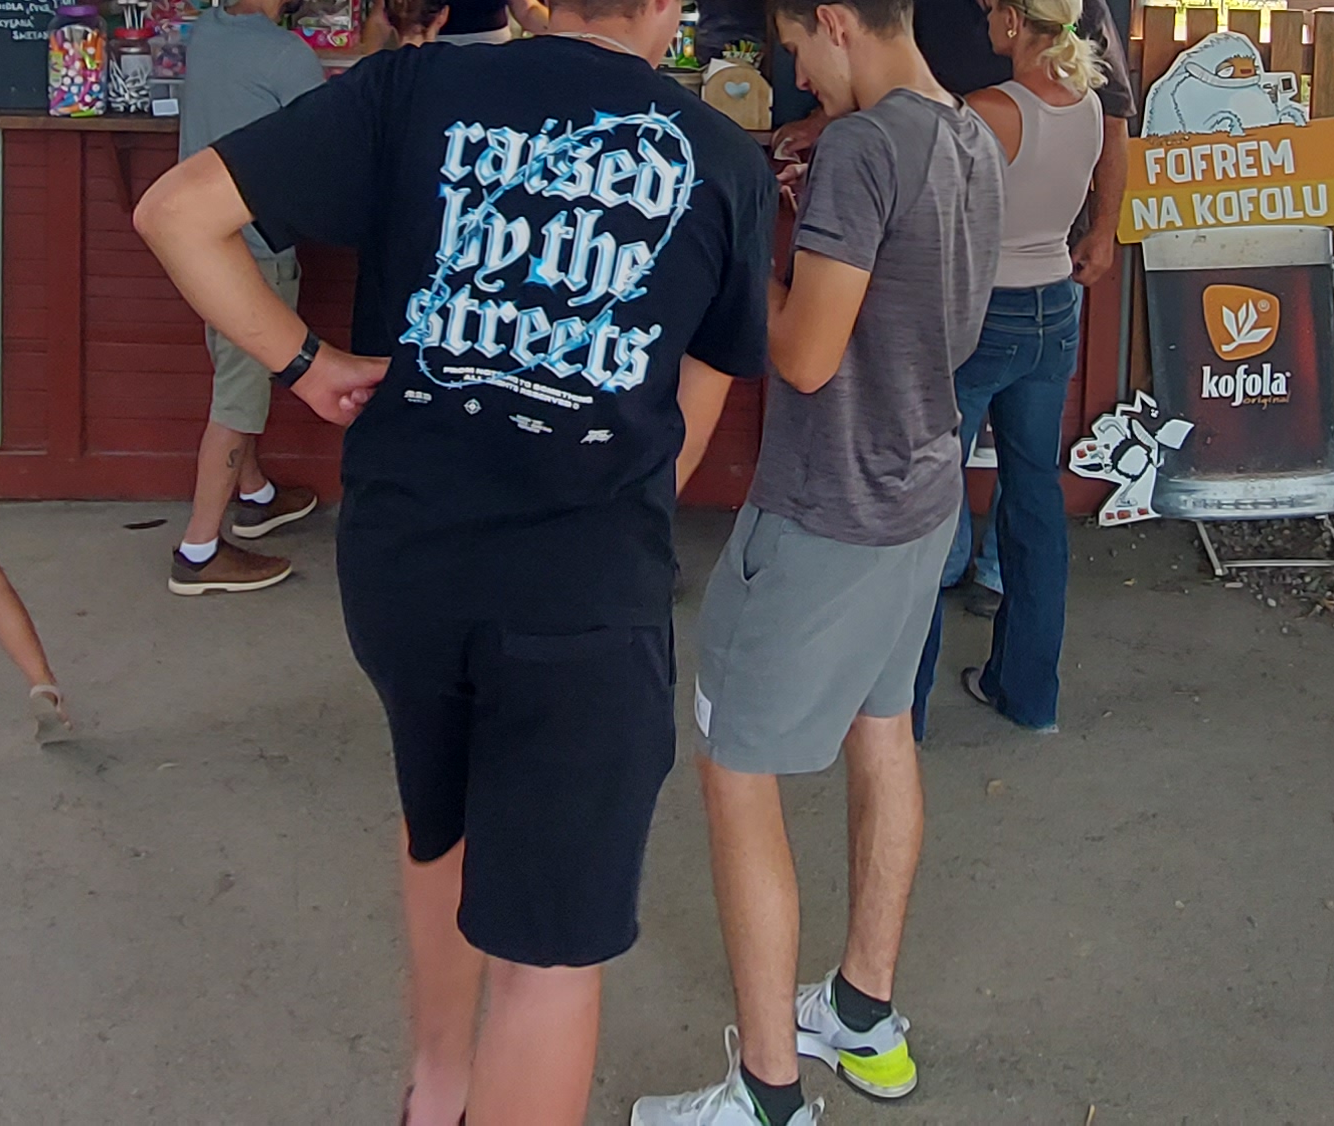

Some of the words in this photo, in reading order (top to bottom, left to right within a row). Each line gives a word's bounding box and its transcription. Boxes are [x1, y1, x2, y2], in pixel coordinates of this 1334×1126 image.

[440, 119, 684, 219] raised
[1145, 139, 1295, 185] FOFREM
[1131, 196, 1183, 230] NA
[1192, 184, 1328, 225] KOFOLU
[435, 186, 531, 292] by
[536, 207, 654, 306] the
[399, 284, 661, 390] streets
[1201, 363, 1287, 406] kofola
[1243, 391, 1291, 410] original
